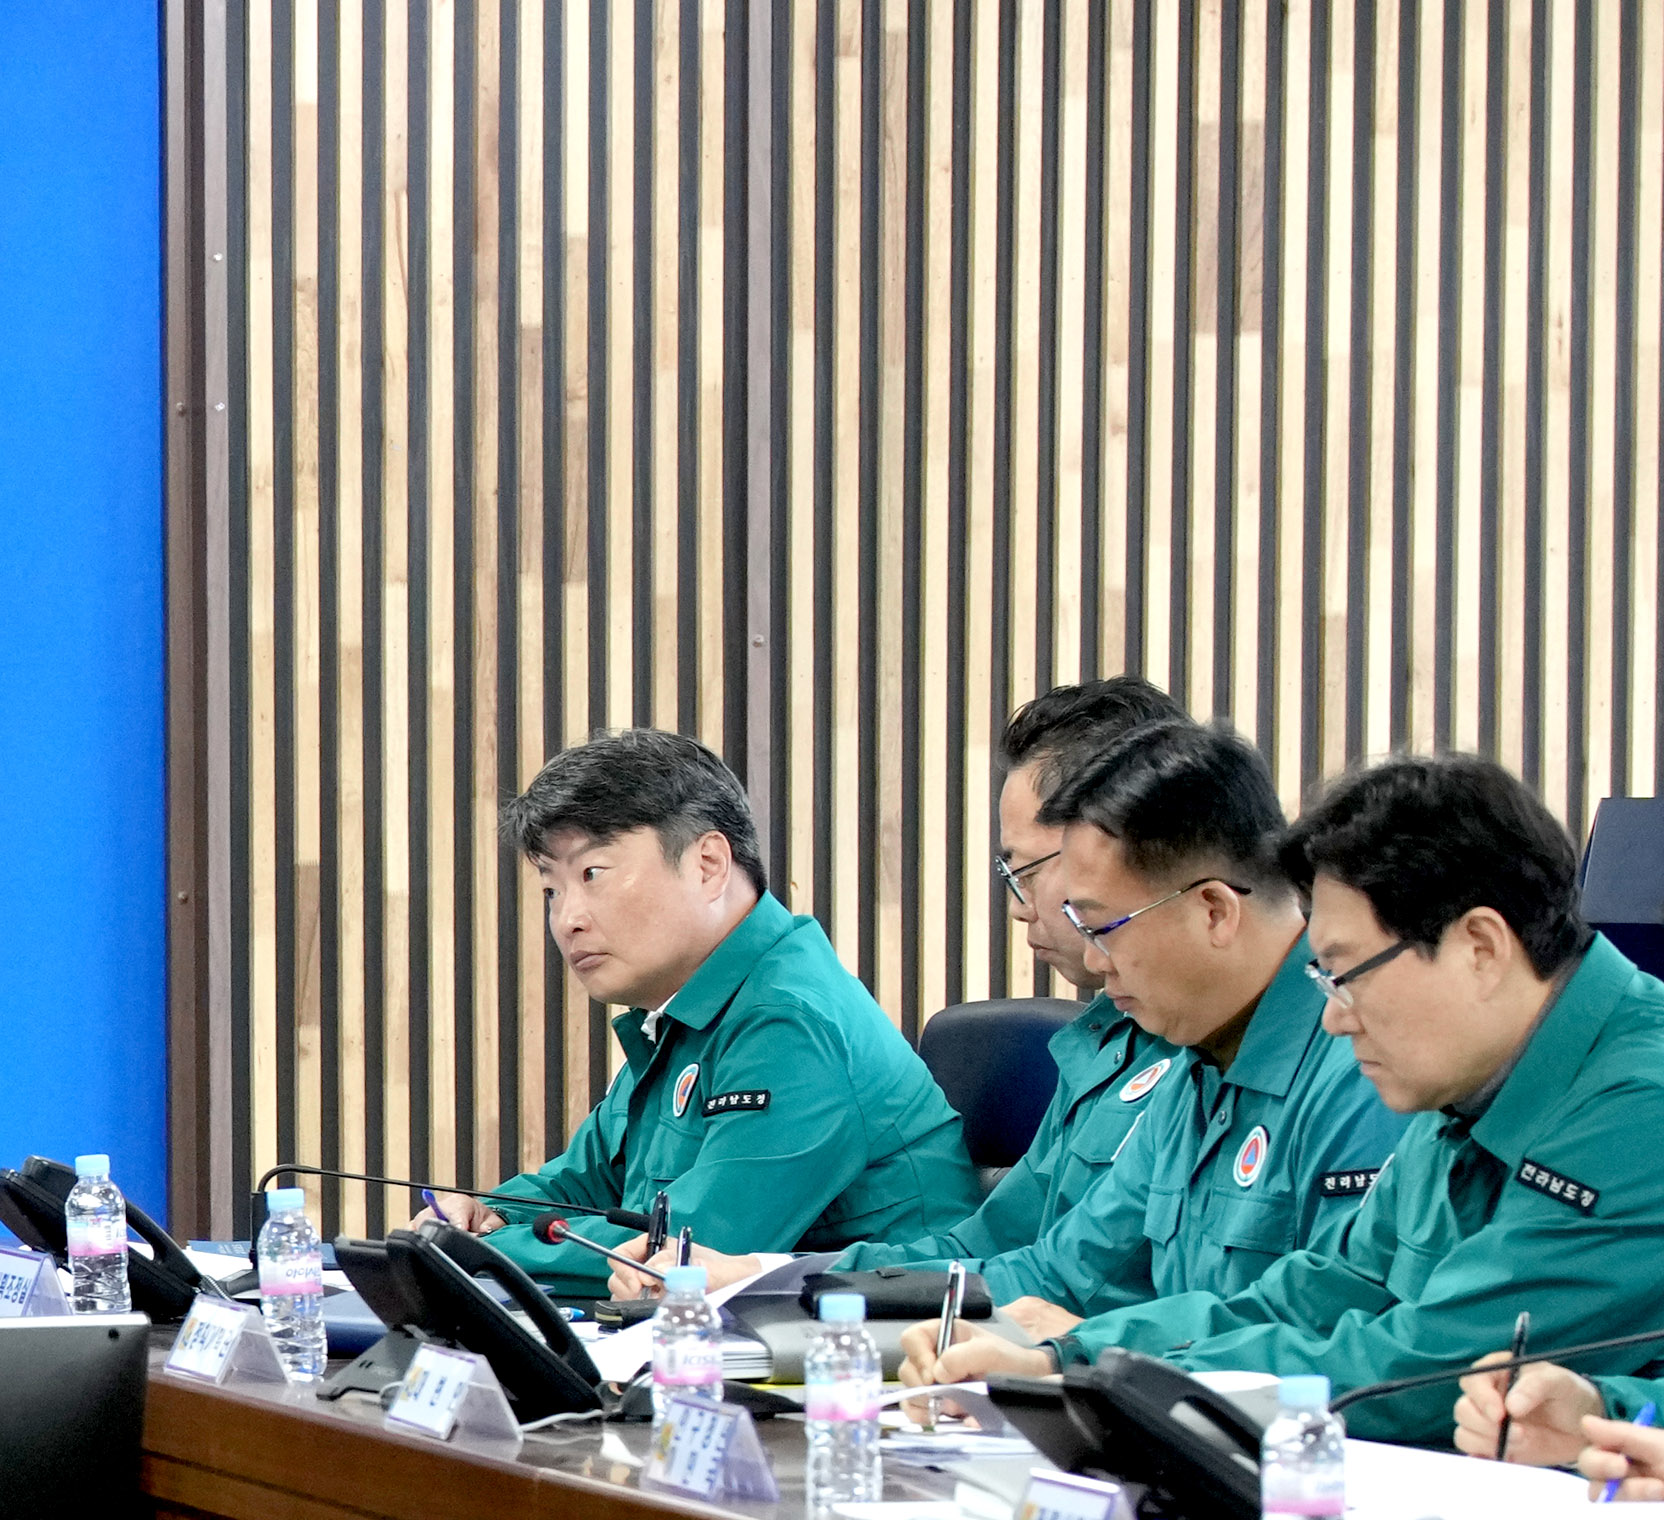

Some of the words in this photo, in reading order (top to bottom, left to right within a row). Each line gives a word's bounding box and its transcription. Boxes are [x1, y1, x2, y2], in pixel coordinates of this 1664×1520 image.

[707, 1093, 766, 1110] 전라남도청
[1324, 1173, 1379, 1190] 전라남도
[1520, 1163, 1595, 1207] 전라남도청
